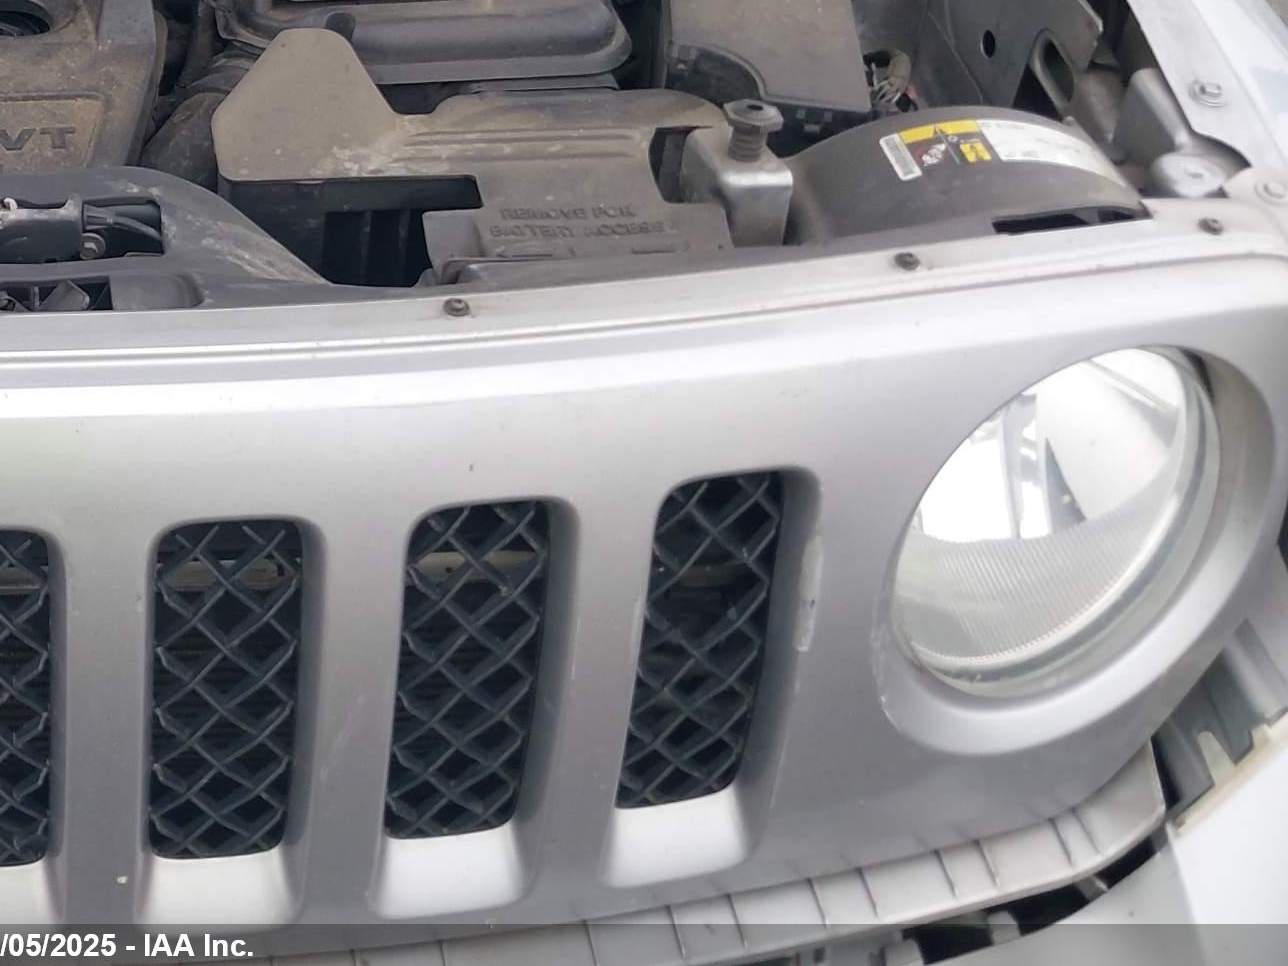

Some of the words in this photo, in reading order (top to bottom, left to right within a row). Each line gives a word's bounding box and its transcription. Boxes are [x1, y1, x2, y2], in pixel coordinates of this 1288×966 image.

[499, 206, 588, 221] REMOVE
[590, 204, 638, 220] FOR
[488, 224, 576, 239] BATTERY
[582, 220, 666, 238] ACCESS
